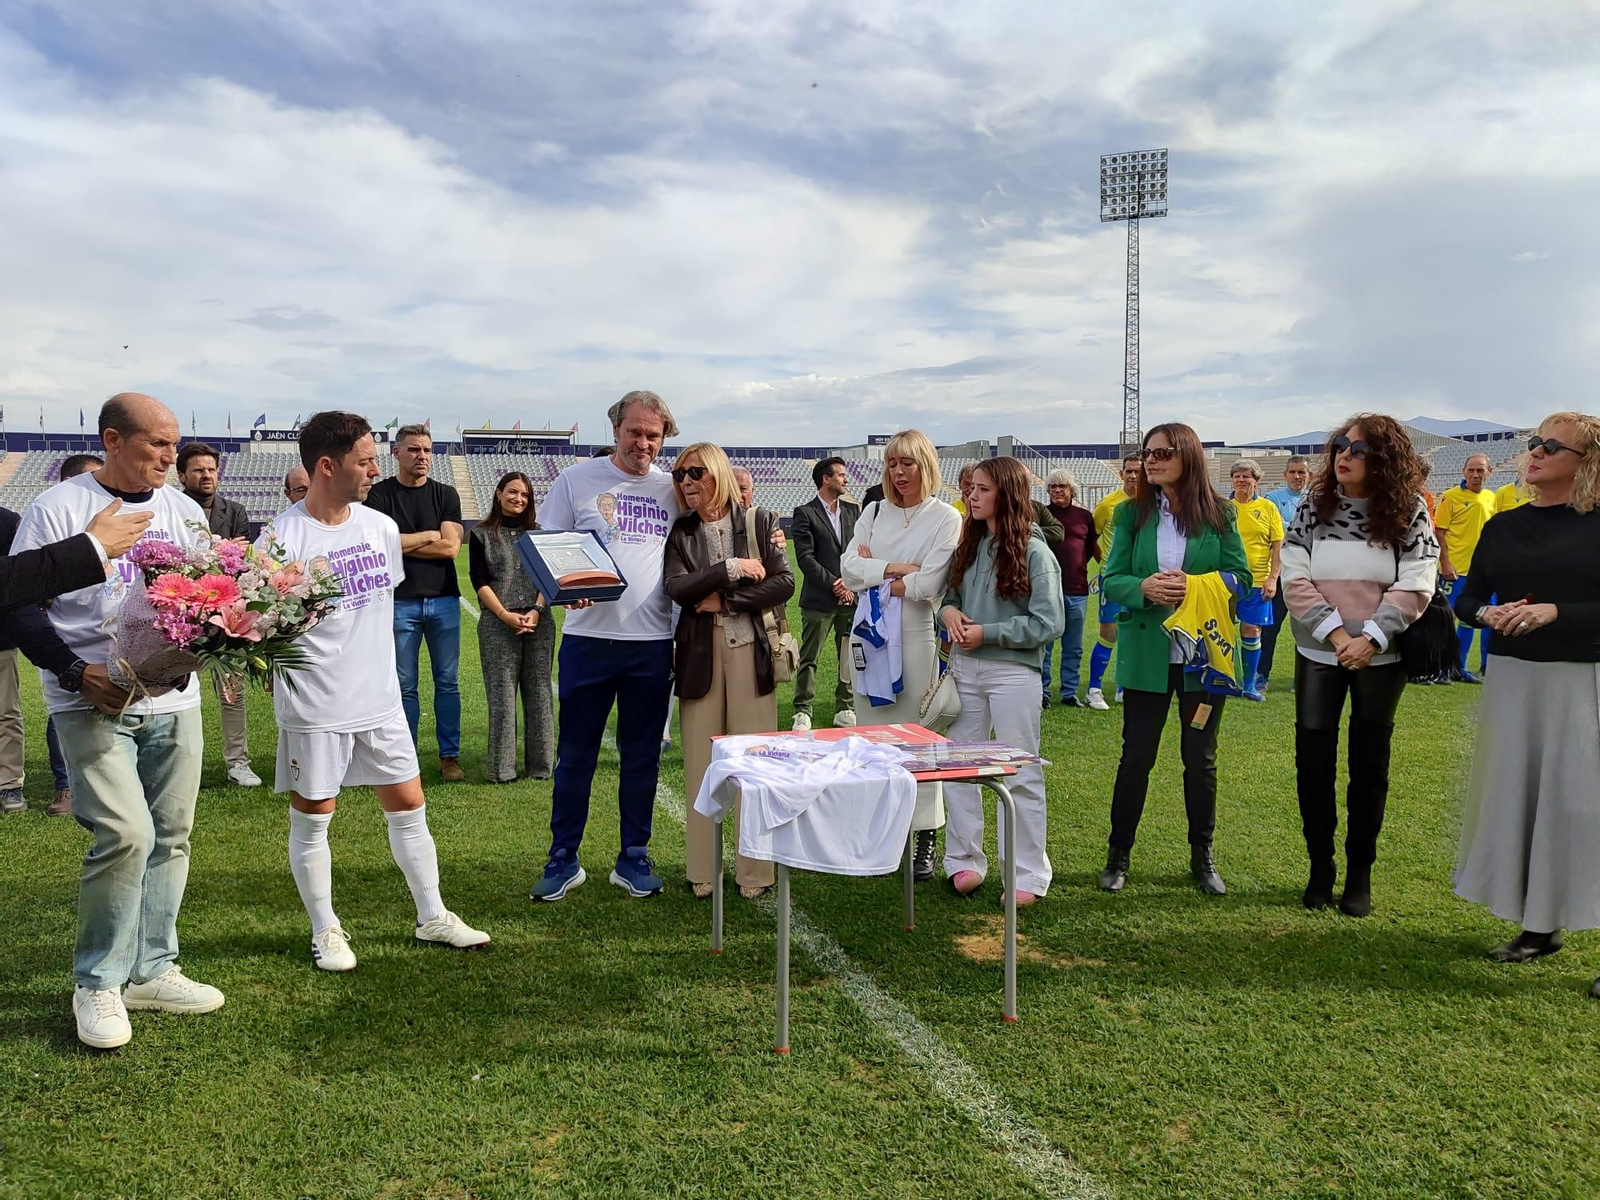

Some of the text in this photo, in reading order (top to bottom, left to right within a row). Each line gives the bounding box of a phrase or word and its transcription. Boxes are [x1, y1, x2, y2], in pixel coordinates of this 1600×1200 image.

[266, 430, 285, 440] JAÉN
[616, 493, 657, 505] Homenaje
[616, 500, 669, 522] Higinio
[143, 528, 170, 540] enaje
[616, 516, 668, 538] Vilches
[328, 541, 371, 560] Homenaje
[330, 550, 387, 578] Higinio
[342, 571, 391, 597] ilches
